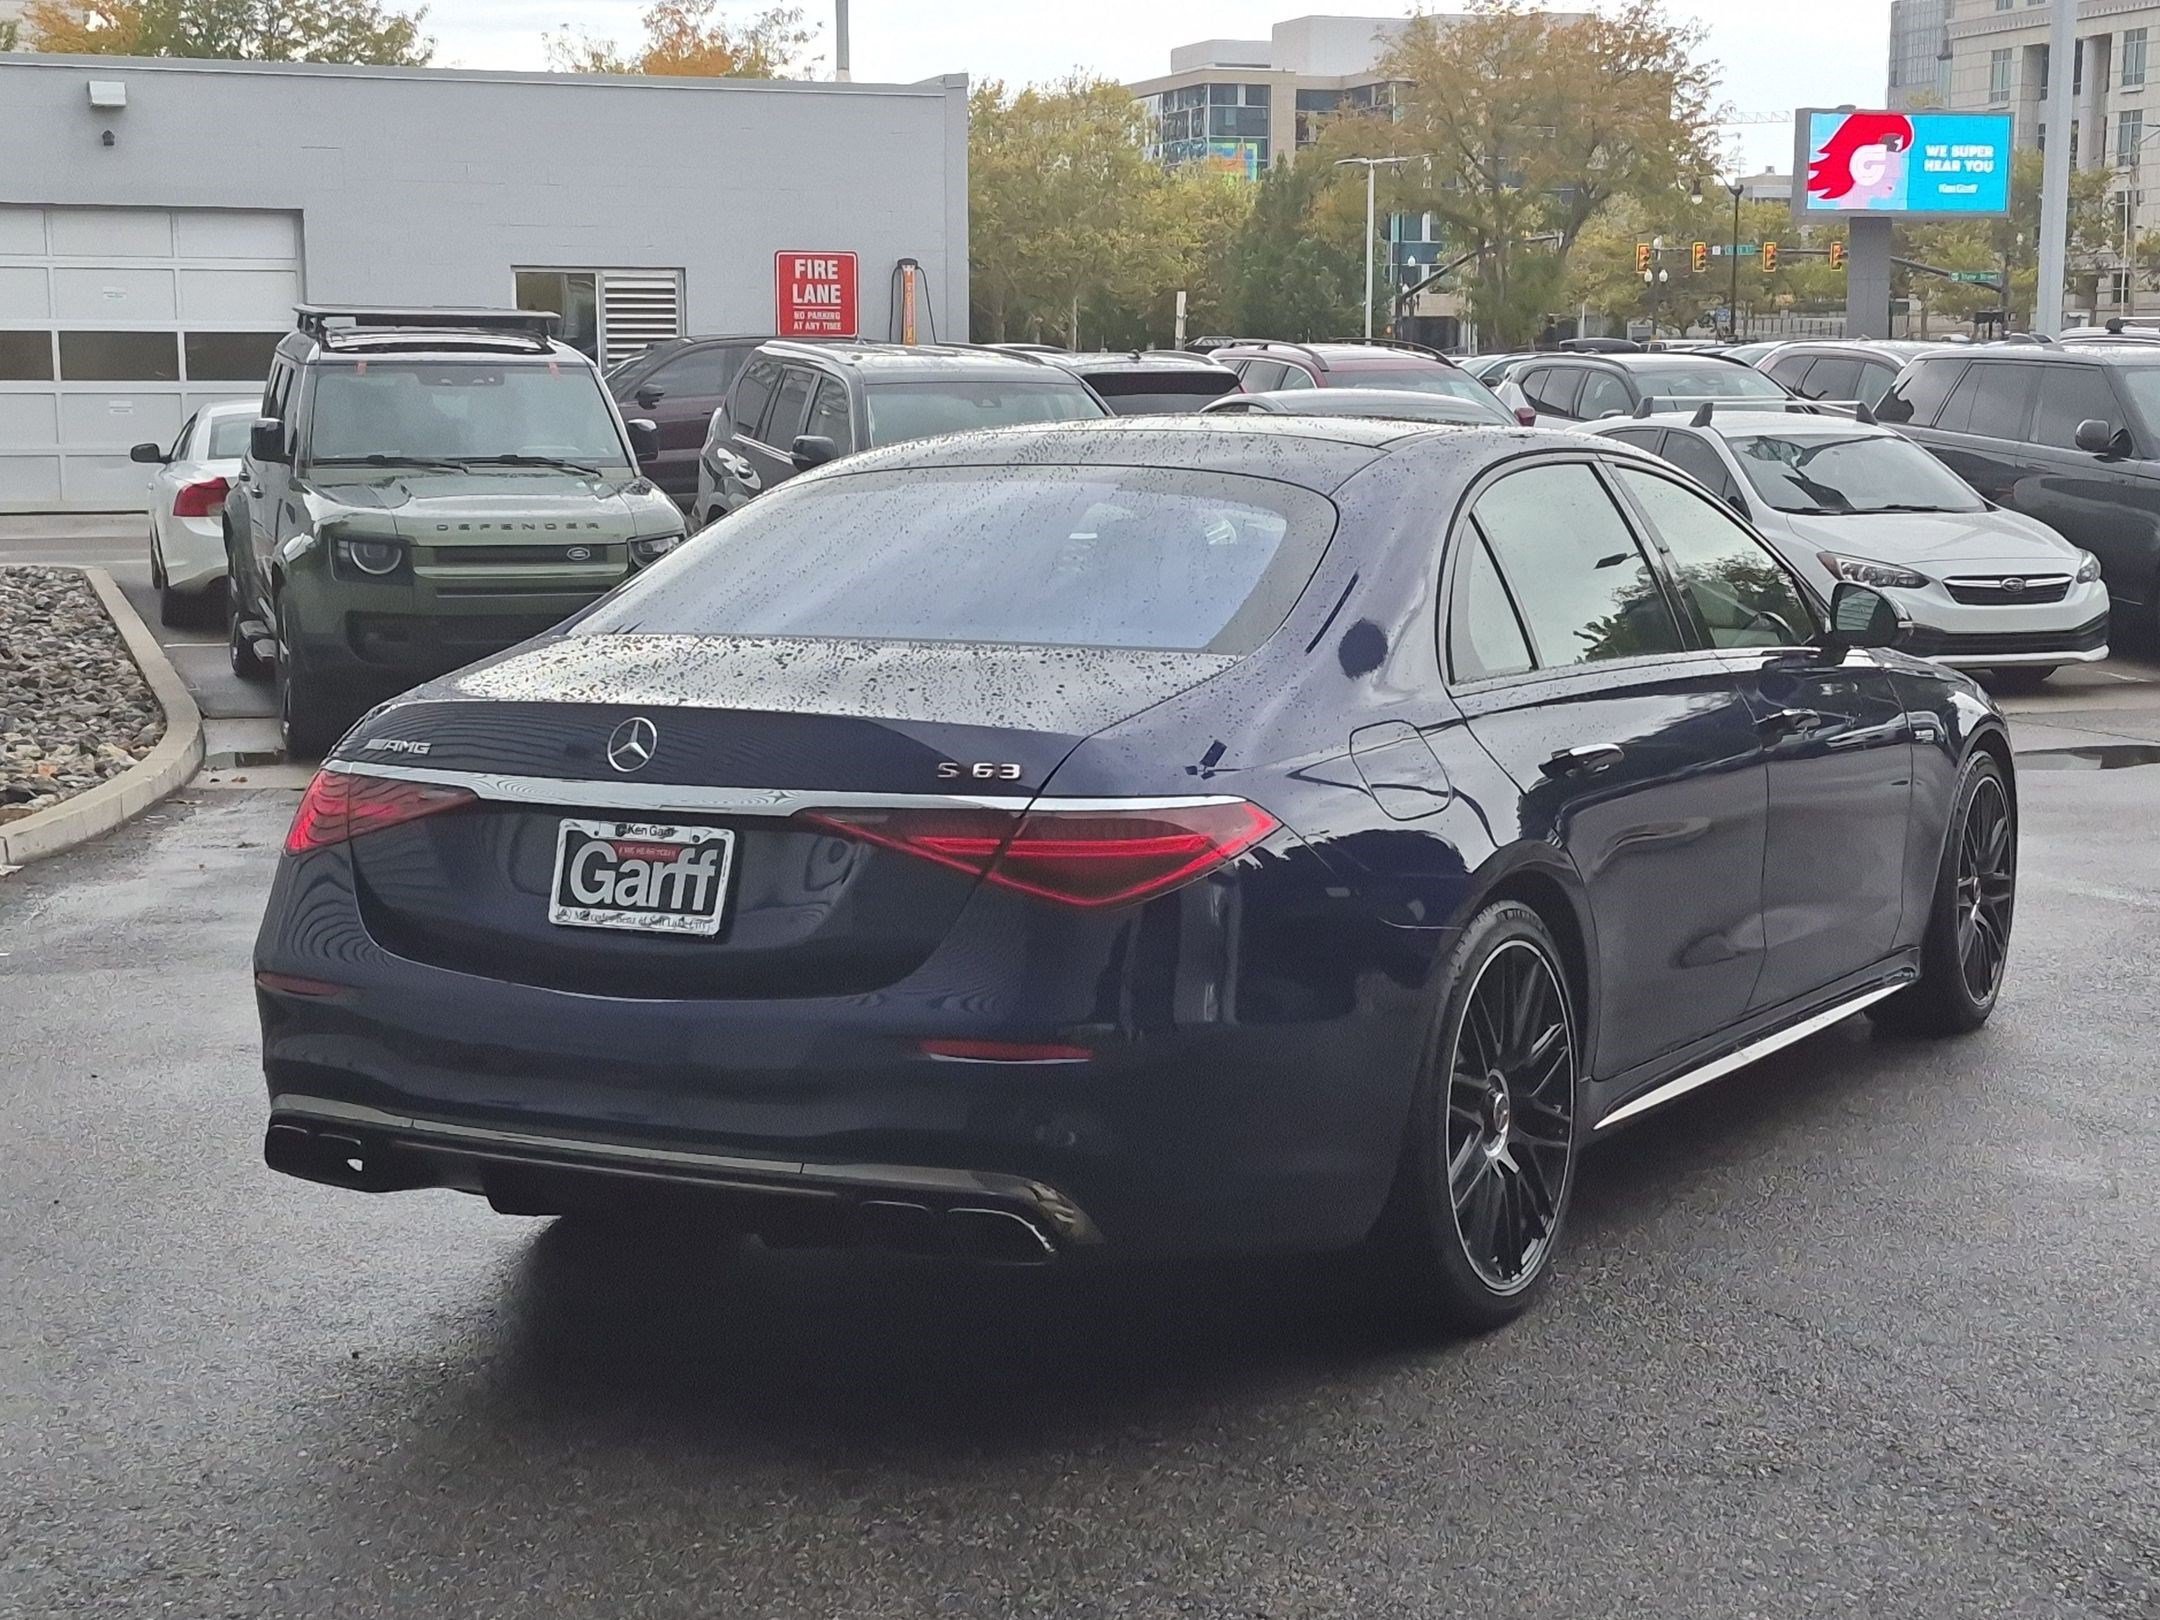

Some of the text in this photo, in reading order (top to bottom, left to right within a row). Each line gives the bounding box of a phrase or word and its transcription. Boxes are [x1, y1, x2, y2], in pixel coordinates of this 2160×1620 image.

[1925, 144, 1995, 158] WE SUPER
[1924, 159, 1995, 173] HEAR YOU
[794, 259, 839, 280] FIRE
[792, 283, 842, 304] LANE
[793, 311, 841, 320] NO PARKING
[793, 321, 842, 331] AT ANY TIME
[436, 522, 600, 532] DEFENDER
[384, 739, 432, 755] AMG
[937, 762, 1021, 780] S 63
[628, 823, 648, 836] Ken
[570, 840, 719, 911] Garff
